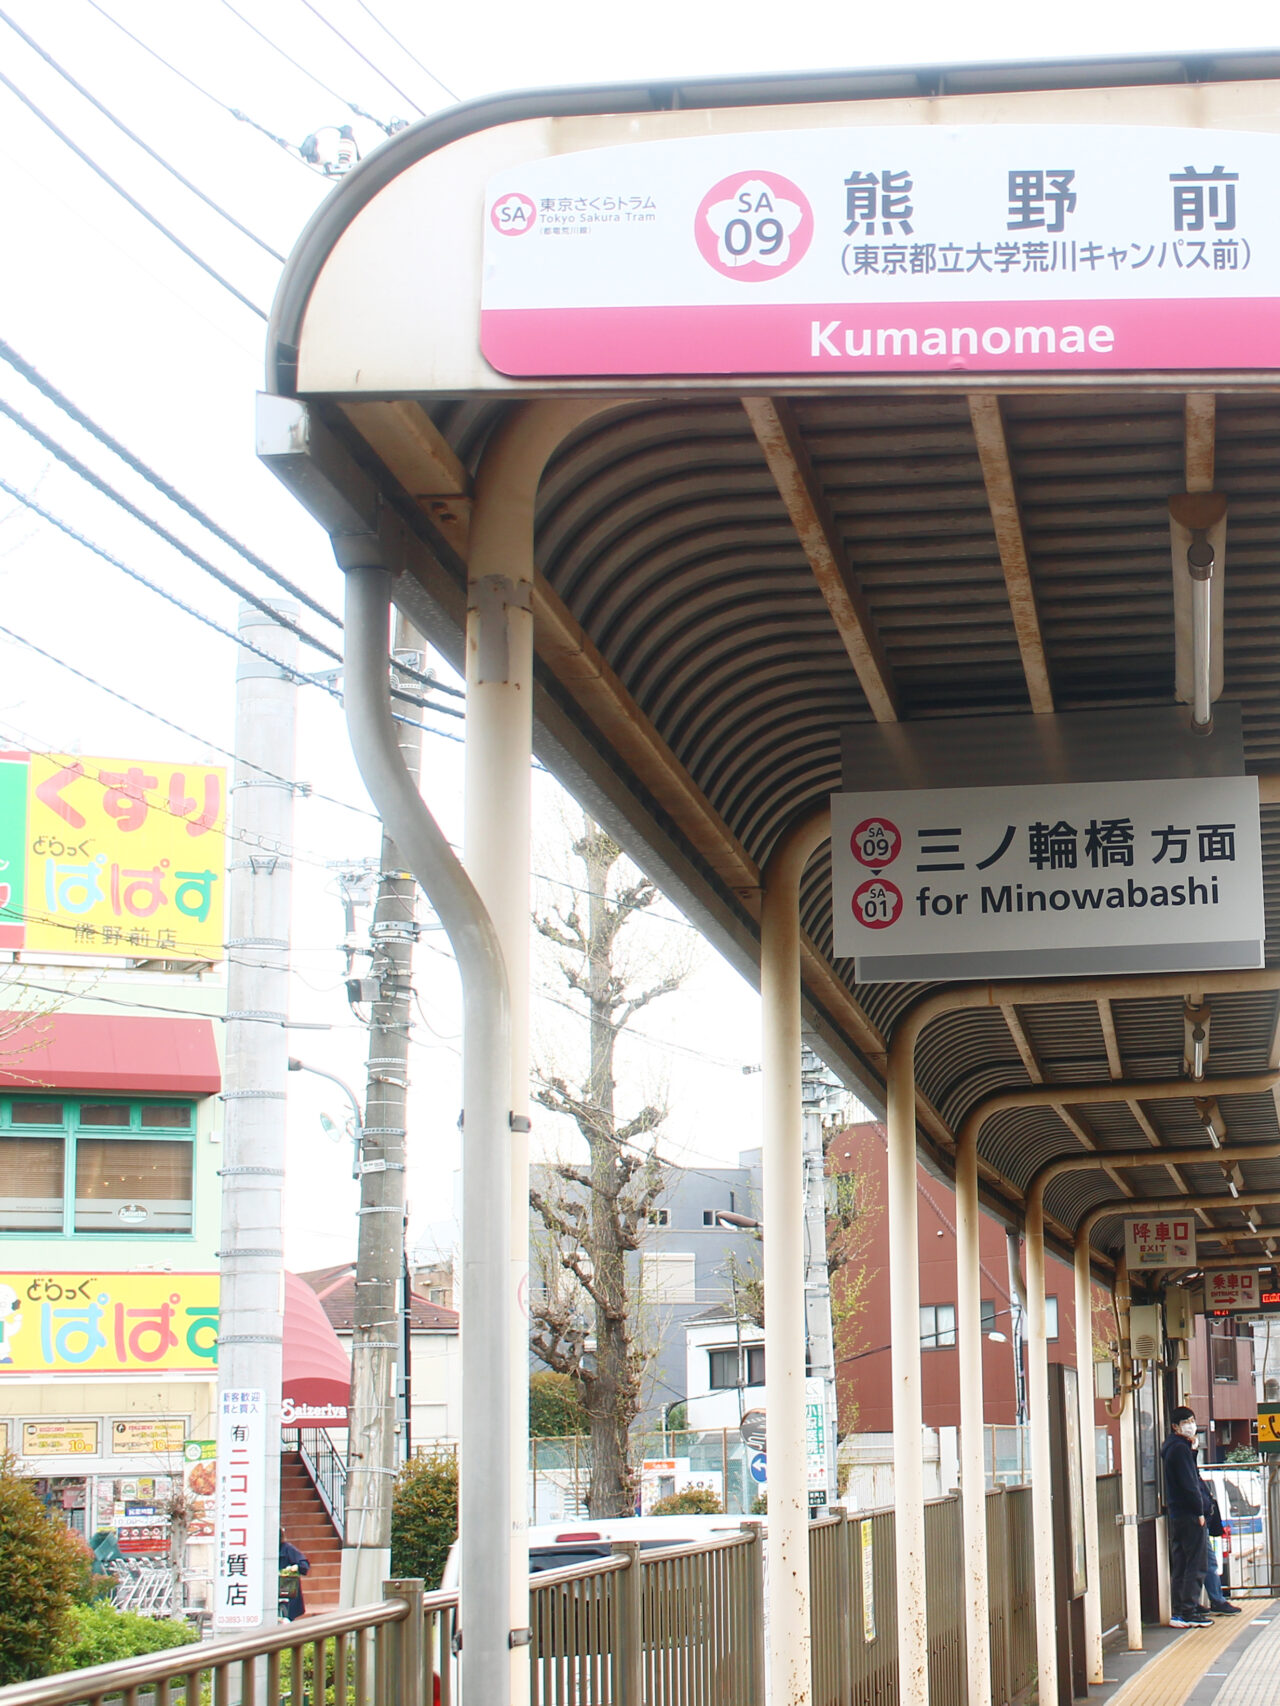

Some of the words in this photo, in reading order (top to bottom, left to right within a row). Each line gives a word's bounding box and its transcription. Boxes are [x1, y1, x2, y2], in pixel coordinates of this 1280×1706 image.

[539, 196, 657, 213] 東京さくらトラム
[738, 192, 774, 213] SA
[500, 206, 526, 223] SA
[539, 213, 575, 225] Tokyo
[579, 212, 621, 223] Sakura
[625, 211, 656, 222] Tram
[724, 217, 784, 255] 09
[841, 237, 1252, 277] （東京都立大学荒川キャンパス前）
[810, 319, 1115, 358] Kumanomae
[35, 761, 221, 838] くすり
[868, 827, 885, 838] SA
[32, 835, 96, 858] どらっぐ
[863, 839, 889, 857] 09
[916, 818, 1135, 873] 三ノ輪橋
[1150, 822, 1237, 865] 方面
[44, 855, 220, 924] ぱぱす
[869, 888, 886, 900] SA
[916, 887, 968, 916] for
[981, 875, 1220, 914] Minowabashi
[864, 900, 888, 918] 01
[74, 923, 178, 949] 熊野前店
[1133, 1222, 1189, 1244] 降車口
[1140, 1244, 1167, 1252] EXIT
[26, 1276, 98, 1302] どらっぐ
[1212, 1273, 1253, 1290] 乗車口
[1210, 1290, 1239, 1298] ENTRANCE
[281, 1398, 348, 1423] Saizeriya
